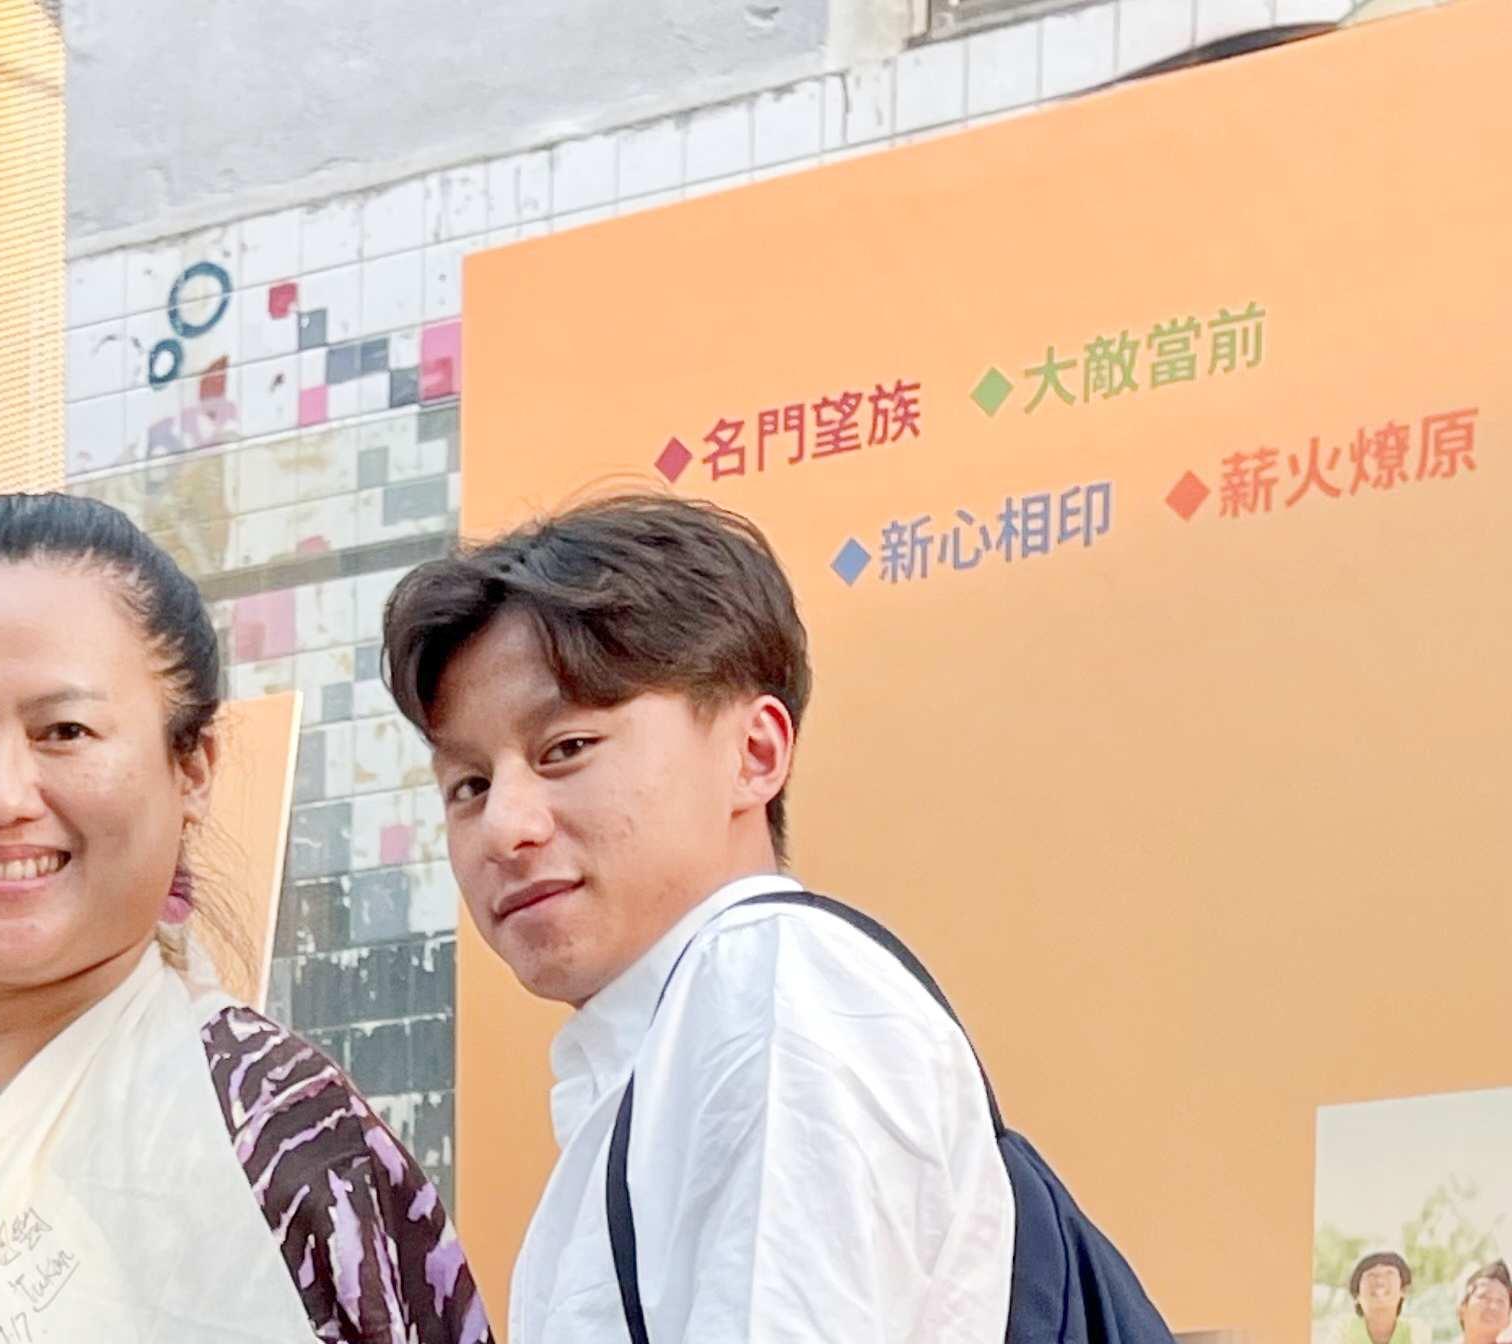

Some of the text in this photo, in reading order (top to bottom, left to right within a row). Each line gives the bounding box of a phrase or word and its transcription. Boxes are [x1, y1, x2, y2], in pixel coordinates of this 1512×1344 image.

[701, 300, 1266, 482] 名門望族 大敵當前
[878, 406, 1480, 585] 新心相印 薪火燎原
